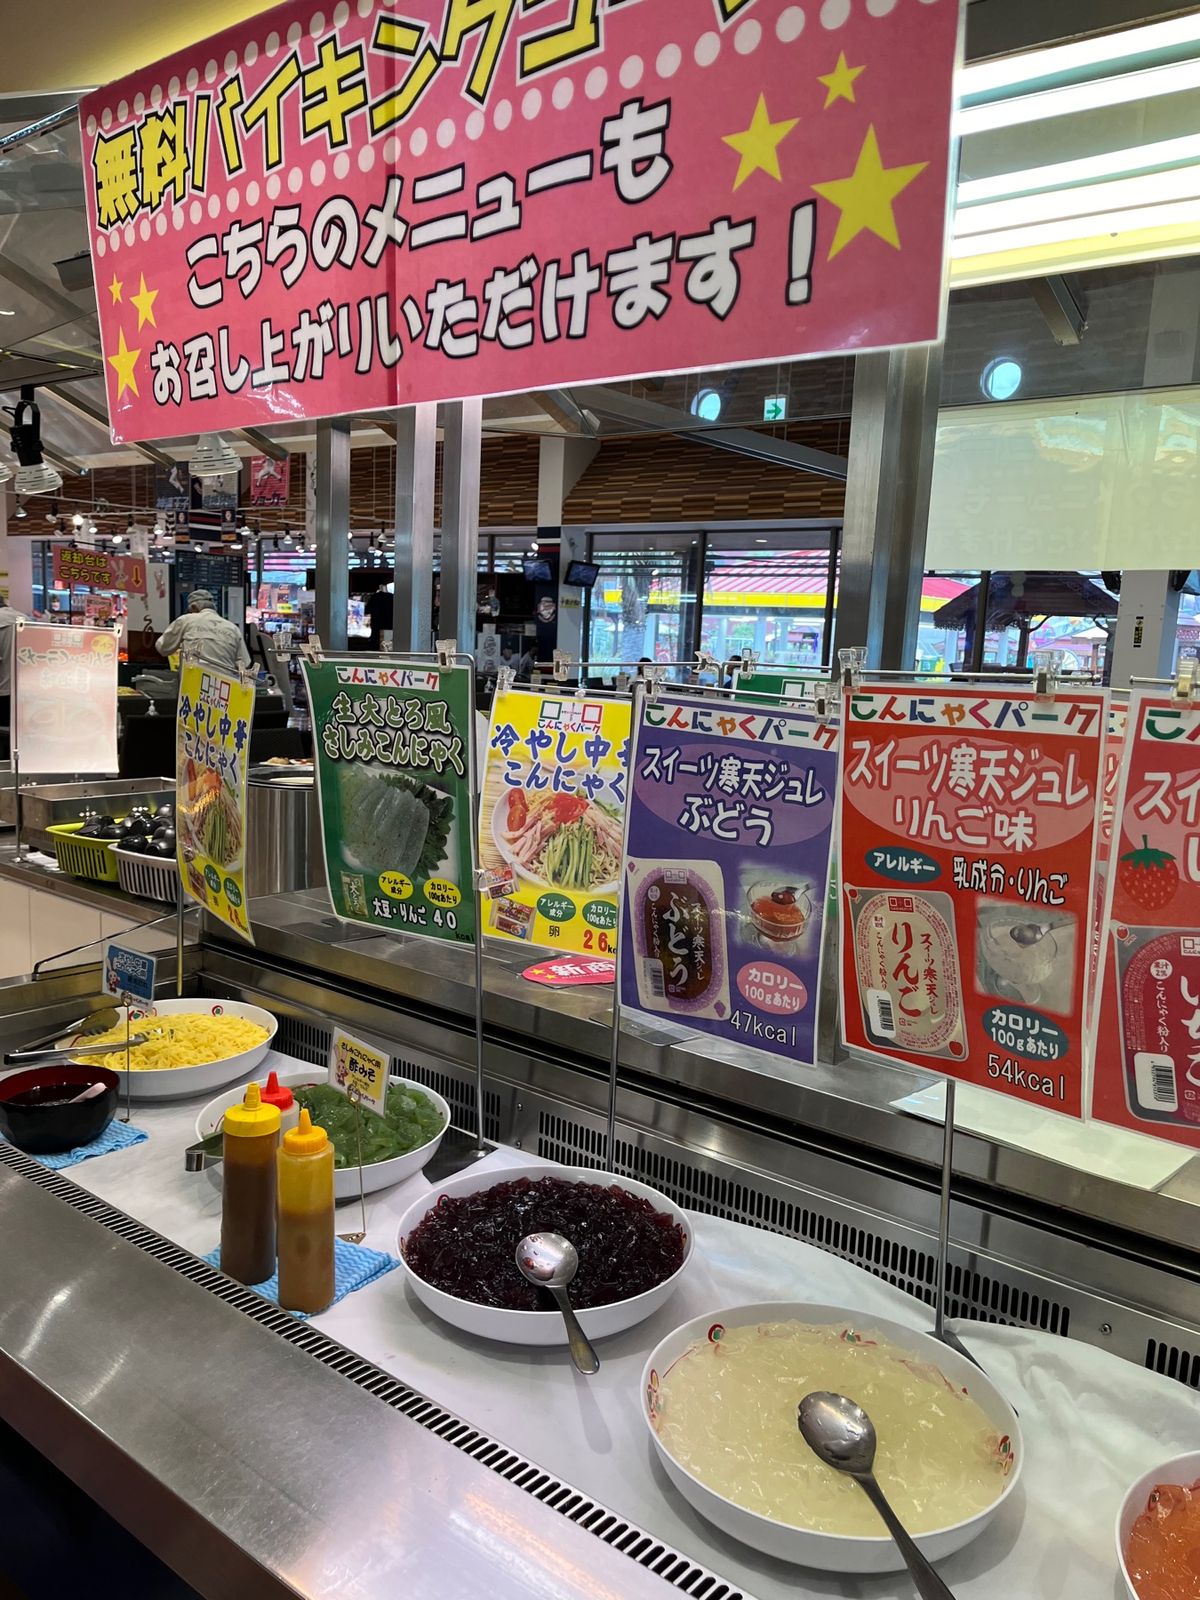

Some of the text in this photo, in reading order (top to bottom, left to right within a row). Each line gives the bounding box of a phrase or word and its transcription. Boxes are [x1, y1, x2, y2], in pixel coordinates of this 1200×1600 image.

[186, 97, 672, 307] こちらのメニューも
[151, 199, 817, 405] お召し上がりいただけます！
[59, 566, 111, 585] こちらです
[61, 549, 107, 567] 返却台は
[337, 668, 439, 690] こんにゃくパーク
[180, 696, 247, 753] 冷やし中華
[332, 691, 451, 734] 生大とろ風
[538, 720, 600, 734] こんにゃくパーク
[645, 704, 839, 749] こんにゃくパーク
[850, 695, 1098, 735] こんにゃくパーク
[1146, 709, 1200, 741] こ
[185, 732, 237, 784] こんにゃく
[323, 724, 465, 776] さしみこんにゃく
[504, 761, 625, 803] こんにゃく
[642, 747, 825, 806] スイーツ寒天ジュレ
[850, 740, 1090, 806] スイーツ寒天ジュレ
[679, 796, 774, 847] ぶどう
[895, 798, 1036, 852] りんご味
[873, 851, 936, 874] アレルギー
[953, 856, 1069, 905] 乳成分・りんご
[381, 877, 411, 888] アレルギー
[430, 882, 455, 893] カロリー
[433, 909, 457, 929] 40
[540, 898, 574, 909] アレルギー
[590, 904, 616, 914] カロリー
[549, 925, 560, 937] 卵
[662, 891, 690, 986] ぶどう
[748, 967, 803, 990] カロリー
[892, 921, 922, 1018] りんご
[744, 985, 801, 1010] 100gあたり
[730, 1010, 797, 1046] 47kcal
[991, 1009, 1059, 1036] カロリー
[991, 1028, 1059, 1060] 100gあたり
[348, 1056, 376, 1083] 酢みそ
[988, 1053, 1065, 1100] 54kcal
